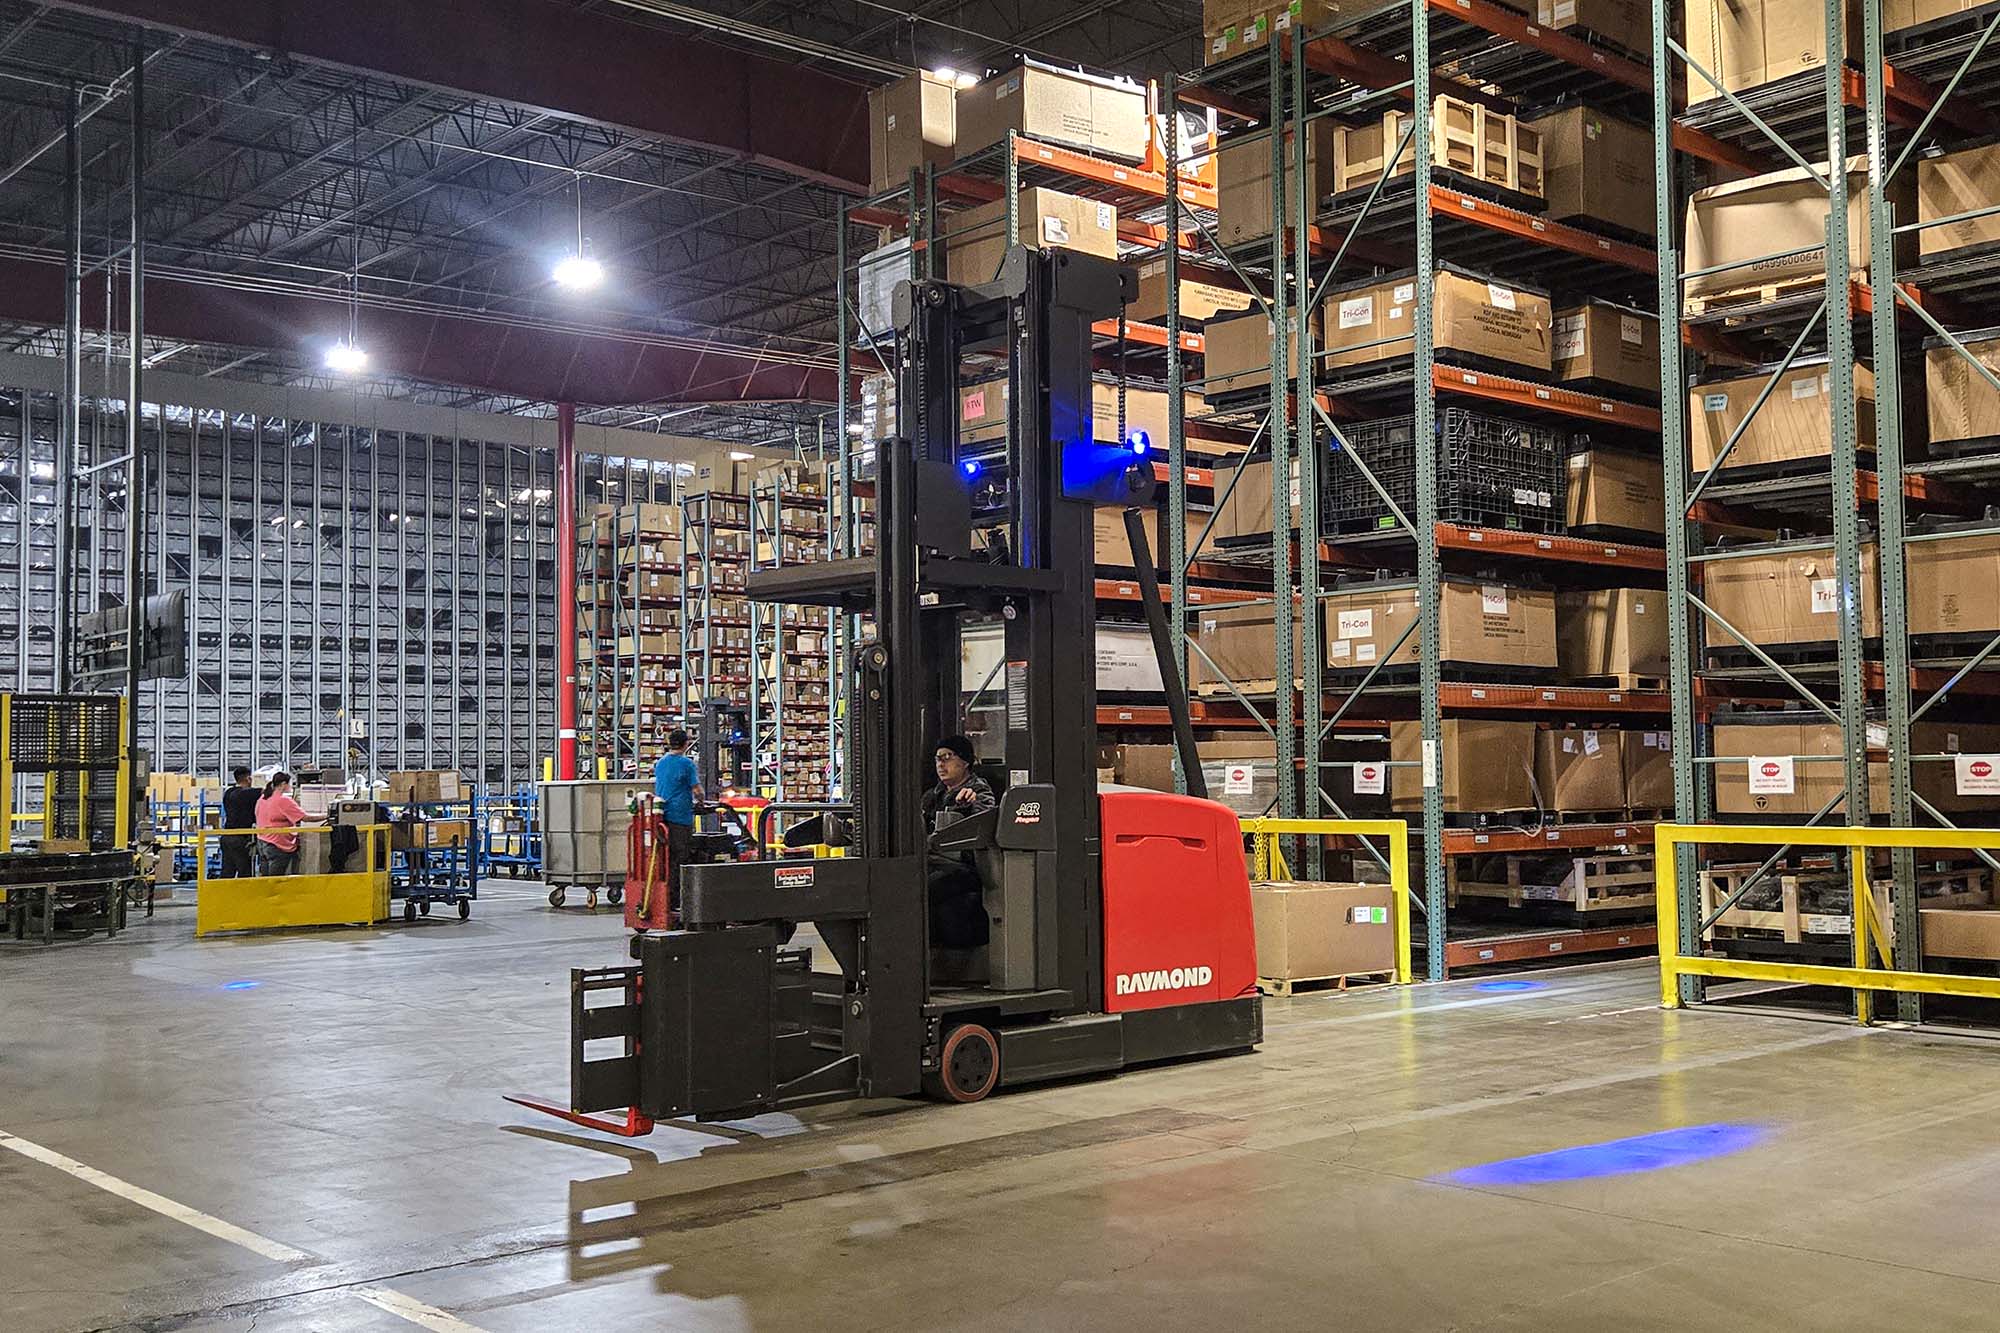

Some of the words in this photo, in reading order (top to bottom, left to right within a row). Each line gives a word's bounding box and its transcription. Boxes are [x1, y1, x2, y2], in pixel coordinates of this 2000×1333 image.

[1343, 307, 1369, 319] Tri-Con
[1341, 620, 1369, 629] Tri-Con
[1015, 802, 1040, 816] ACR
[1116, 966, 1213, 996] RAYMOND
